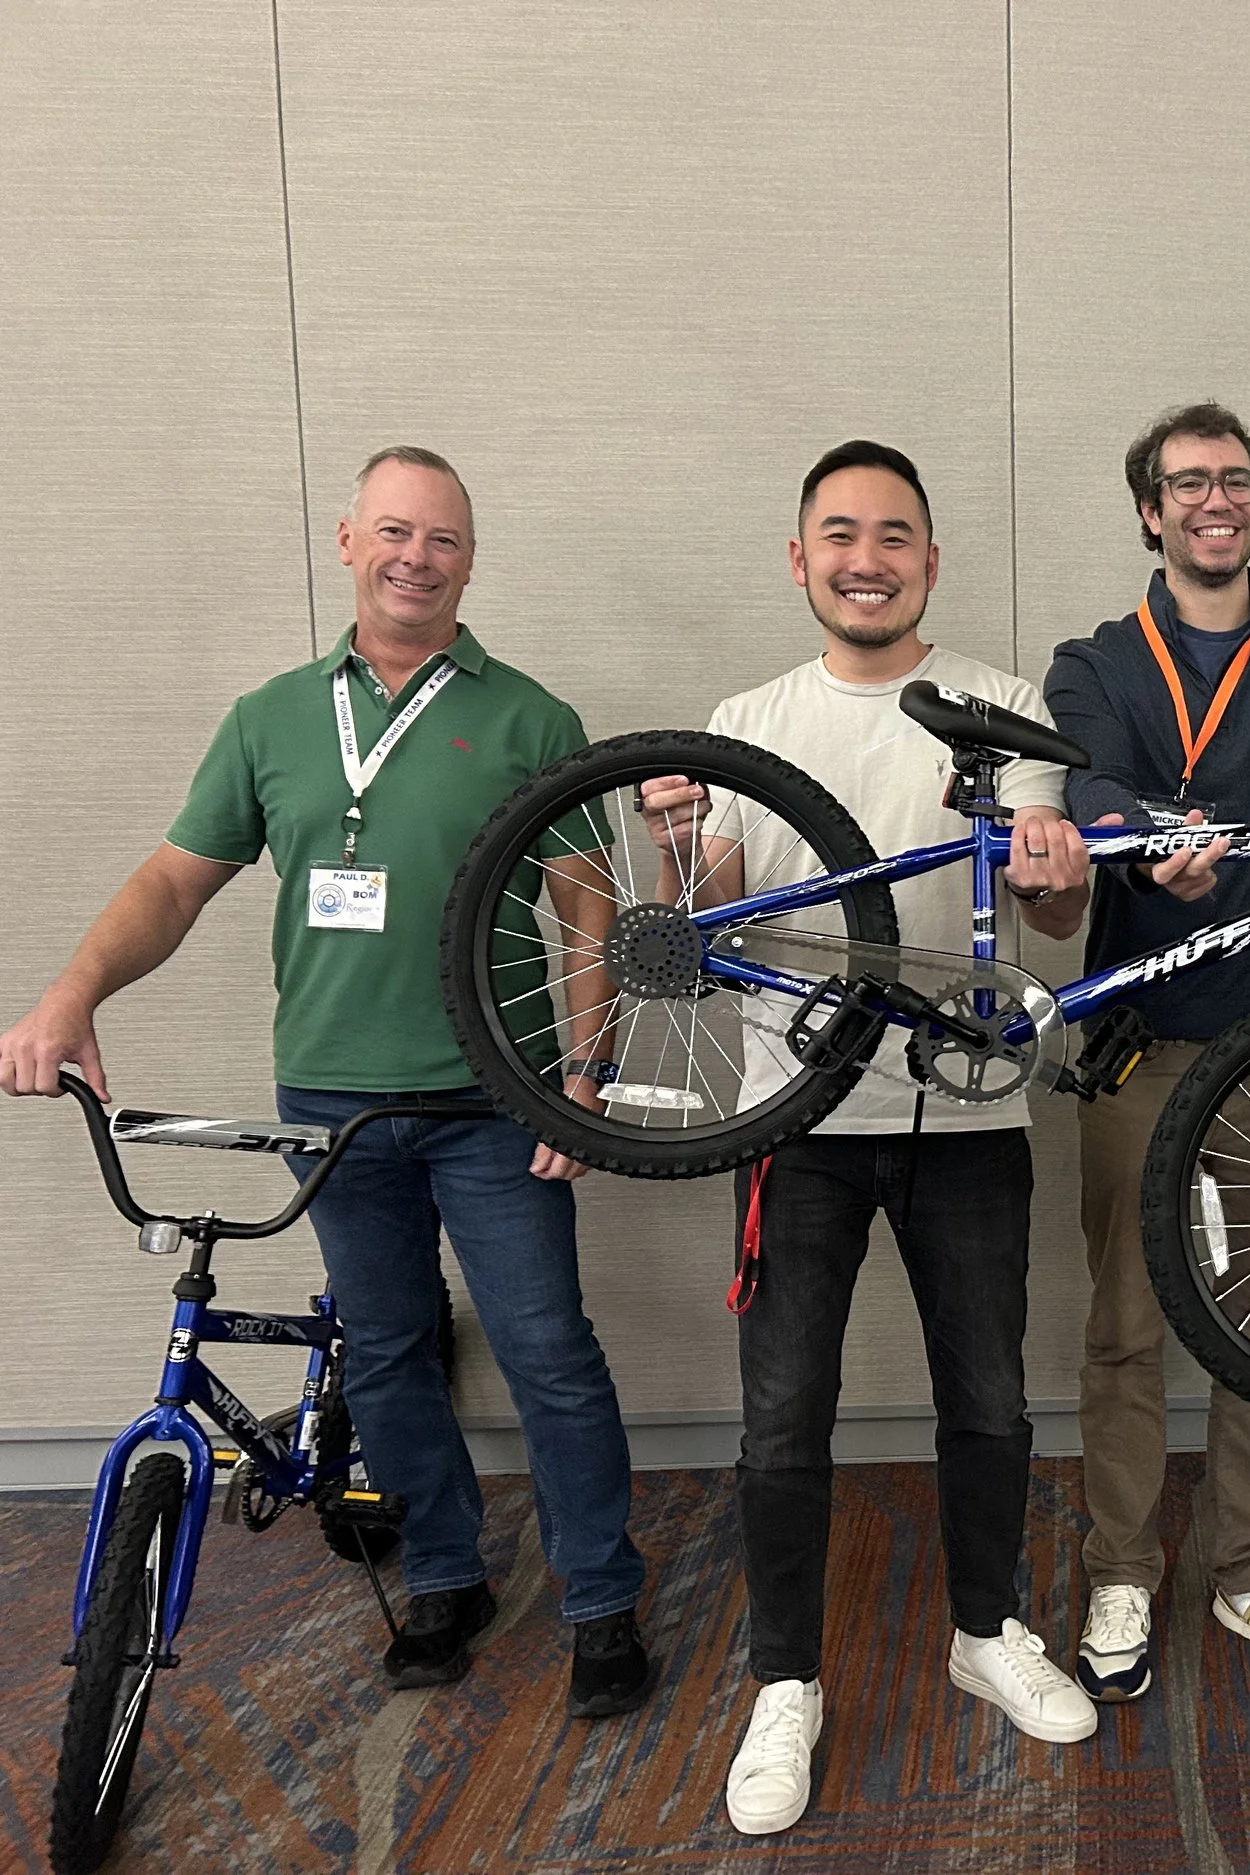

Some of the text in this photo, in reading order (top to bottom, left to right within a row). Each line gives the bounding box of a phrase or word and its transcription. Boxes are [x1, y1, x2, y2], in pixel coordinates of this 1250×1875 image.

[340, 700, 355, 756] PIONEER TEAM
[381, 698, 424, 748] PIONEER TEAM
[1151, 815, 1185, 826] MICKEY
[228, 1318, 268, 1337] ROCK
[217, 1392, 270, 1440] HUFFY
